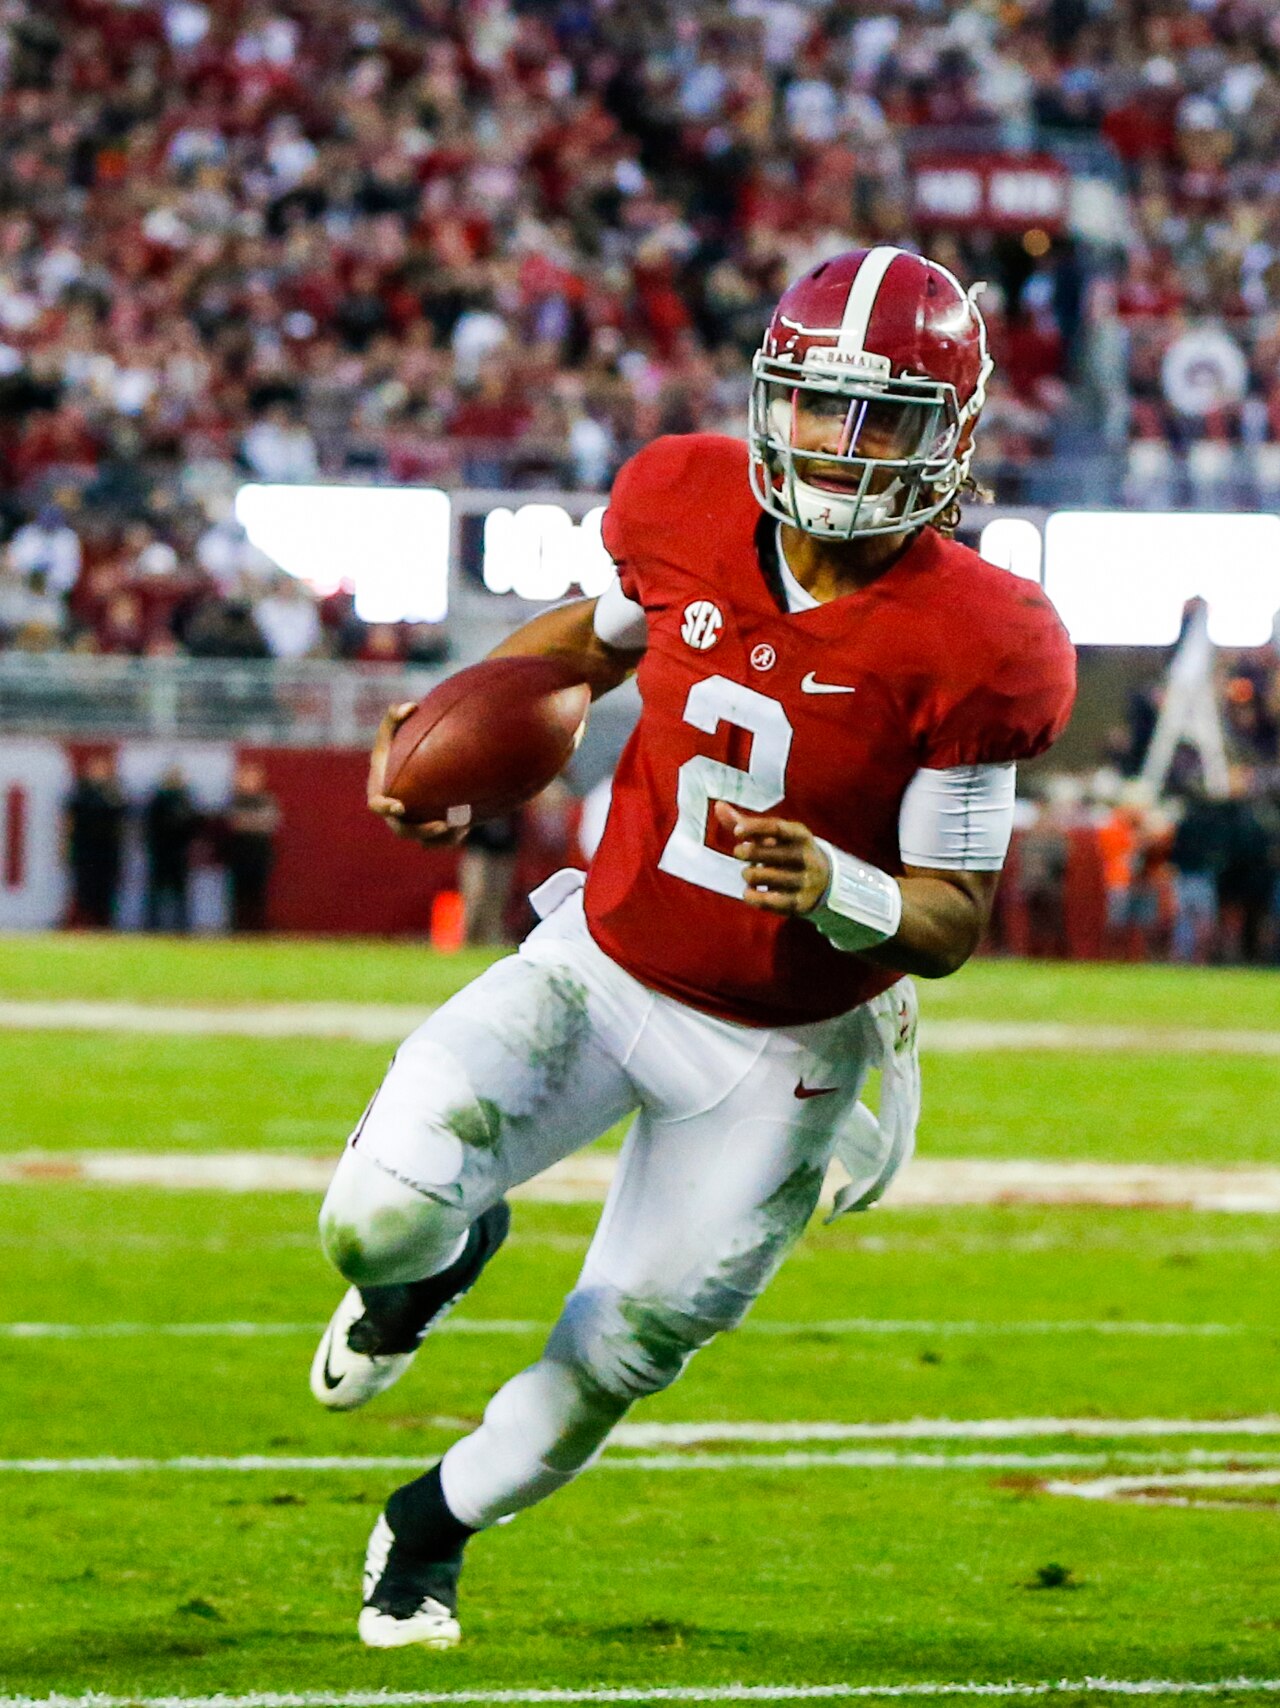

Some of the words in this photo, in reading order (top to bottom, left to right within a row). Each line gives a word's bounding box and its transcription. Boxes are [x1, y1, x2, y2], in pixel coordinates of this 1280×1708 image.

[826, 350, 866, 367] BAMA
[681, 600, 724, 650] SEC
[658, 674, 794, 899] 2
